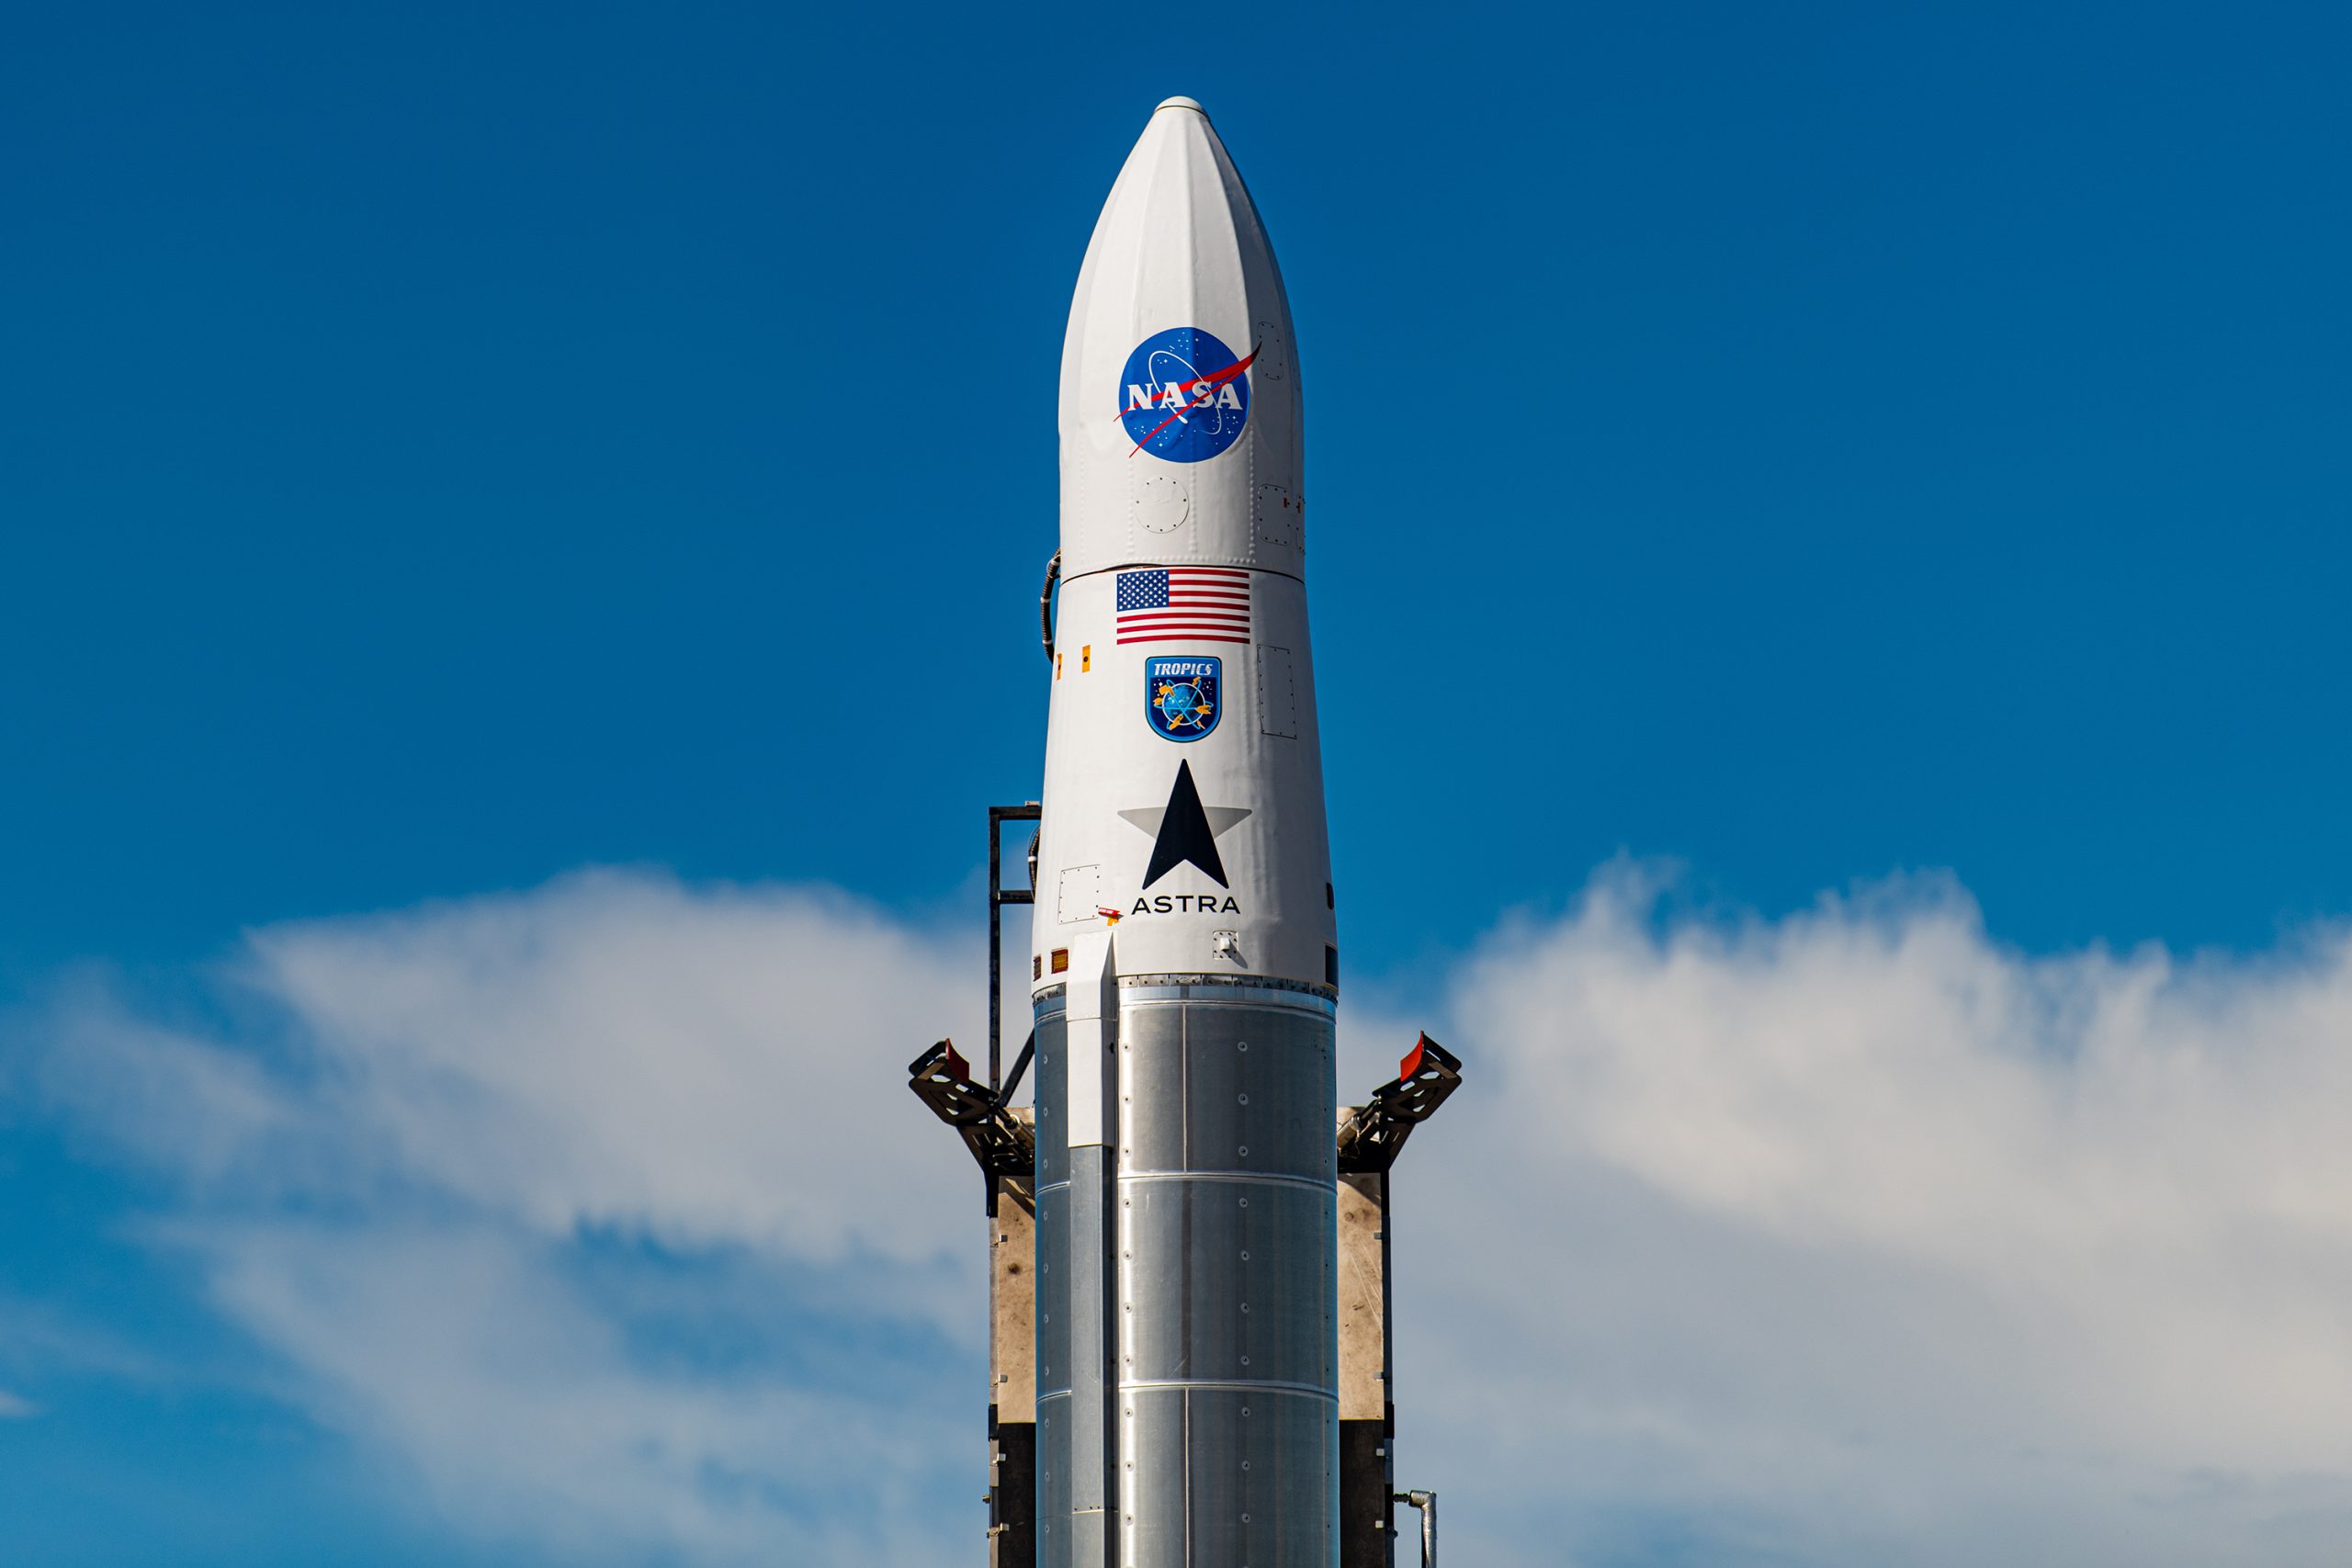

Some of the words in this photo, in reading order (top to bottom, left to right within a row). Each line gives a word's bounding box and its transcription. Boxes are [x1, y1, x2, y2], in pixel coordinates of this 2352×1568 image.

[1127, 381, 1243, 411] NASA
[1154, 663, 1213, 676] TROPICS
[1131, 896, 1241, 915] ASTRA
